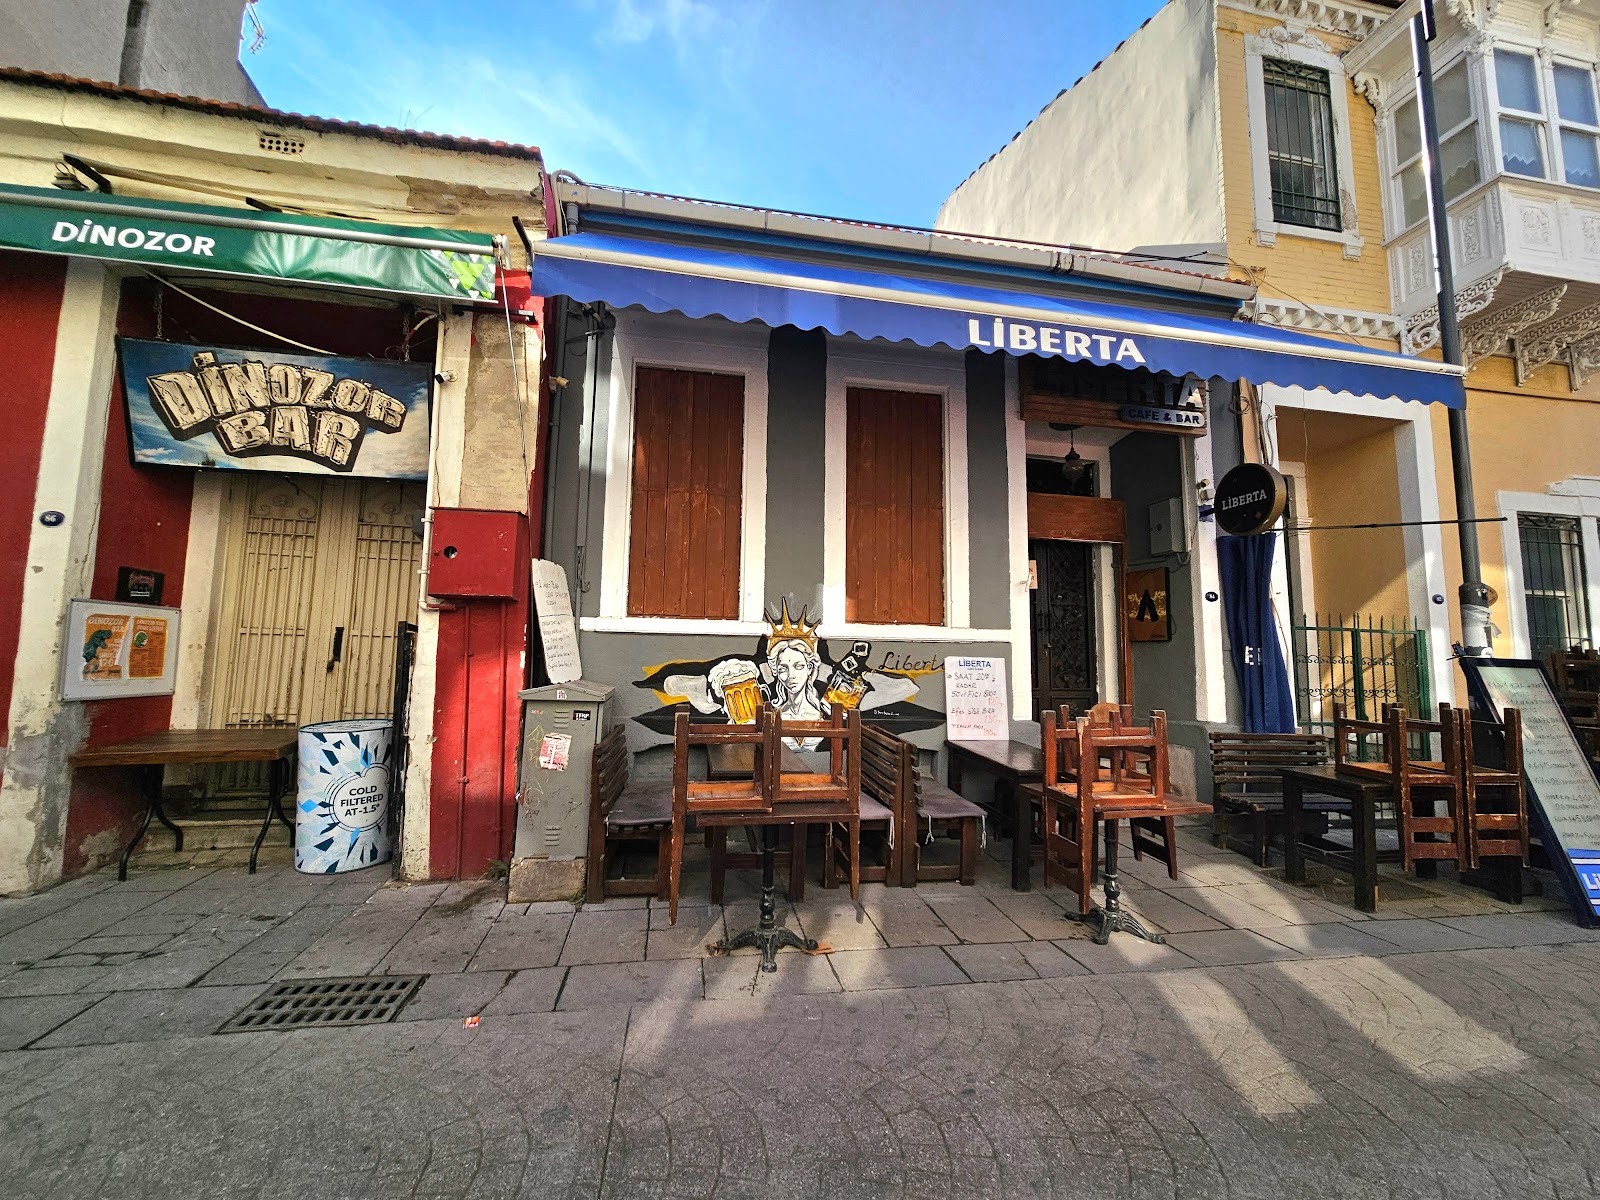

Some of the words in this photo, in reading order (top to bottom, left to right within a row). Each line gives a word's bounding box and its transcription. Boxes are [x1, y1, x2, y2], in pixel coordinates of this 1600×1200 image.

[968, 317, 1147, 364] LİBERTA
[1128, 408, 1160, 421] CAFE
[1163, 412, 1172, 422] &
[1175, 413, 1200, 425] BAR
[216, 406, 360, 466] BAR
[1221, 489, 1267, 511] LİBERTA
[958, 658, 991, 668] LİBERTA
[349, 785, 378, 796] COLD
[340, 793, 384, 807] FILTERED
